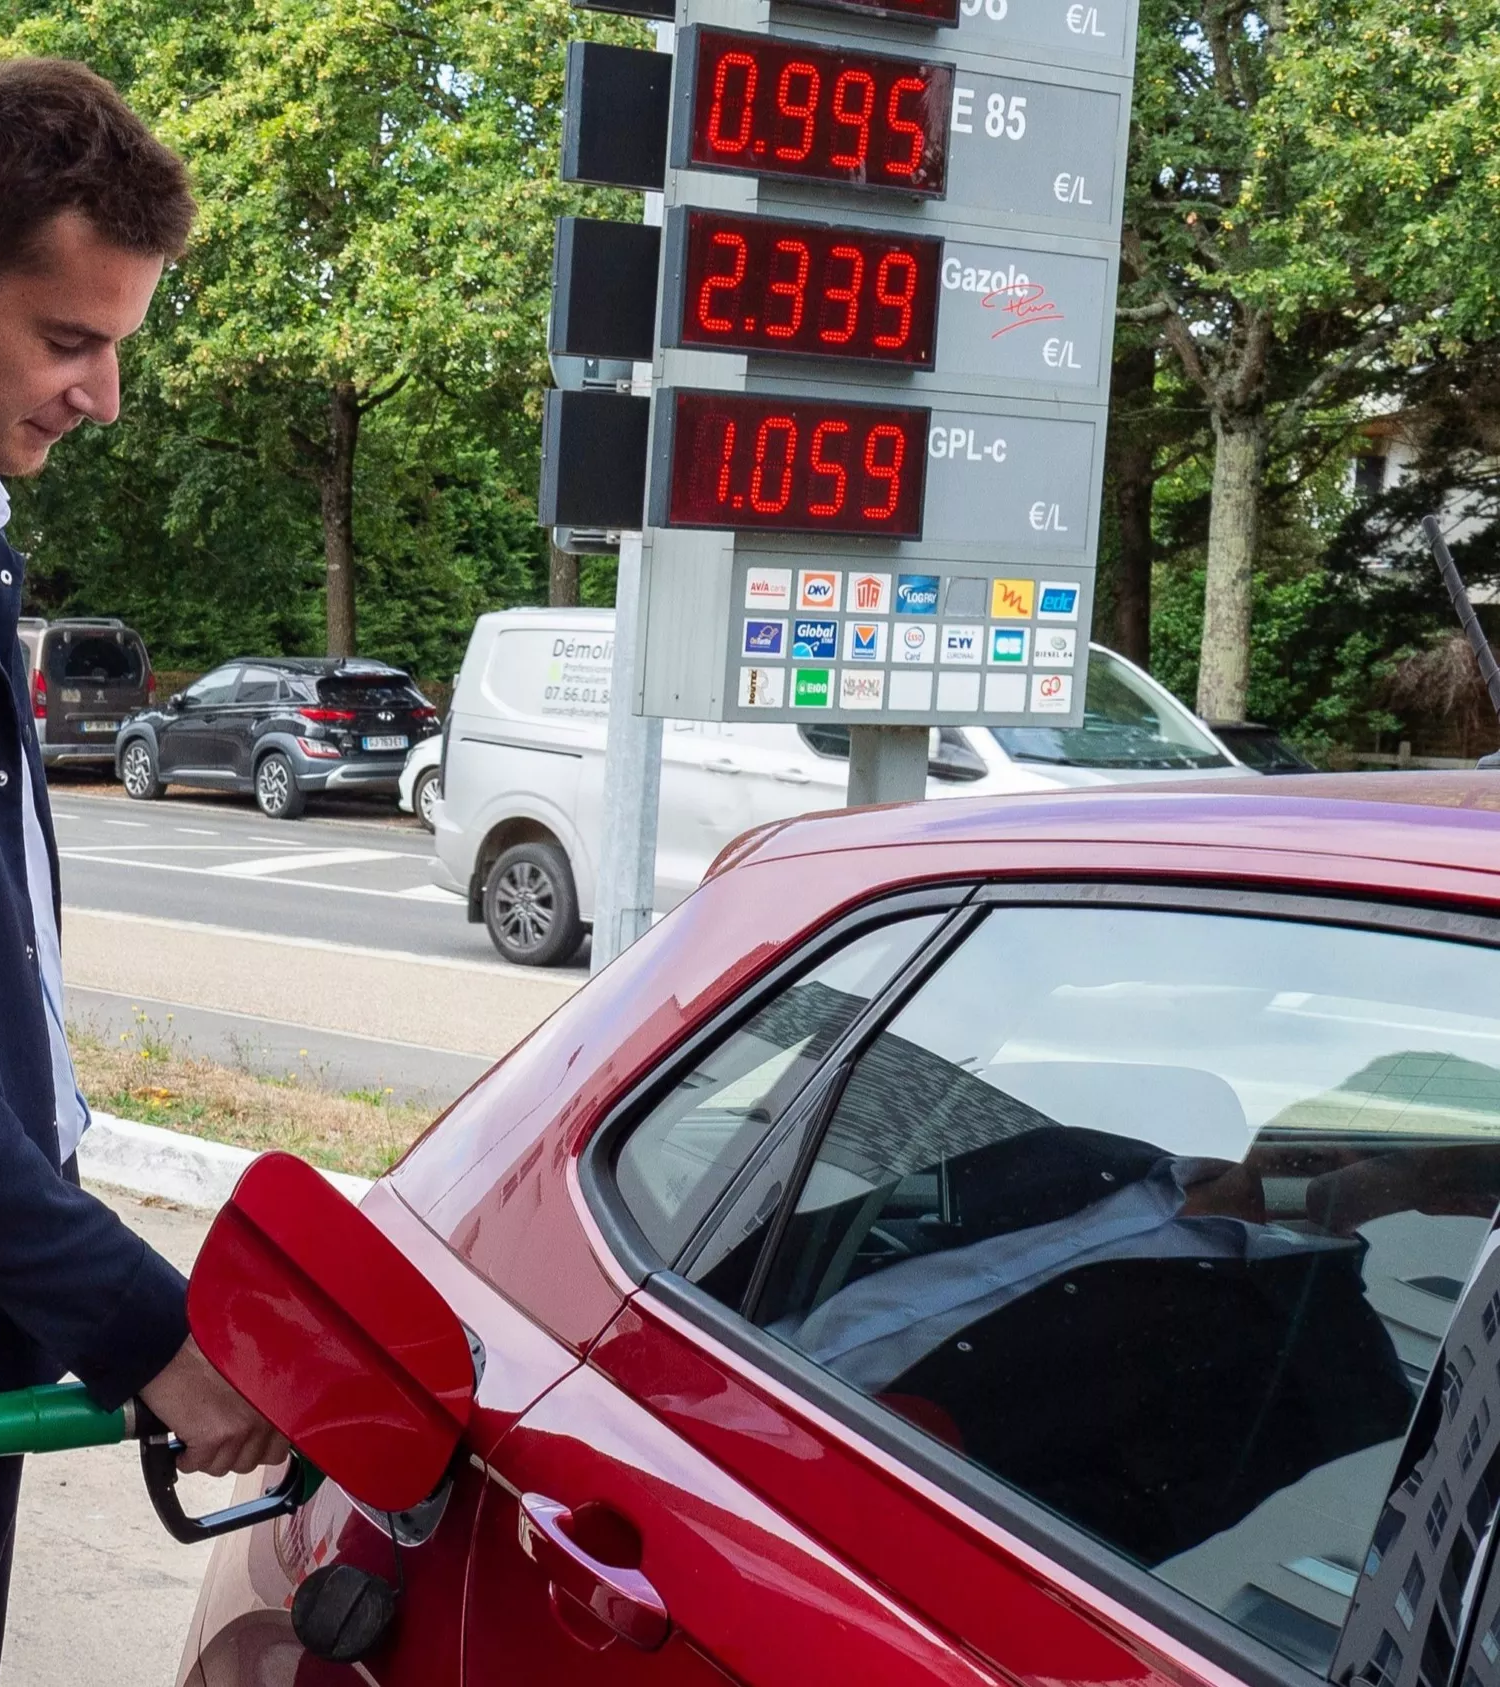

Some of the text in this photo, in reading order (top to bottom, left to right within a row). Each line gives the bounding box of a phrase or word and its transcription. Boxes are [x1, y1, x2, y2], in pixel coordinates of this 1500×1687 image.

[1066, 4, 1106, 37] €/L
[708, 51, 926, 175] 0.995
[951, 87, 1027, 141] E 85
[1053, 172, 1093, 206] €/L
[698, 231, 918, 349] 2.339
[941, 257, 1030, 298] Gazole
[1043, 337, 1082, 370] €/L
[928, 426, 1008, 463] GPL-c
[715, 416, 906, 520] 1.059
[1028, 501, 1068, 533] €/L
[807, 584, 831, 597] DKV
[797, 623, 835, 638] Global
[904, 651, 921, 662] Card
